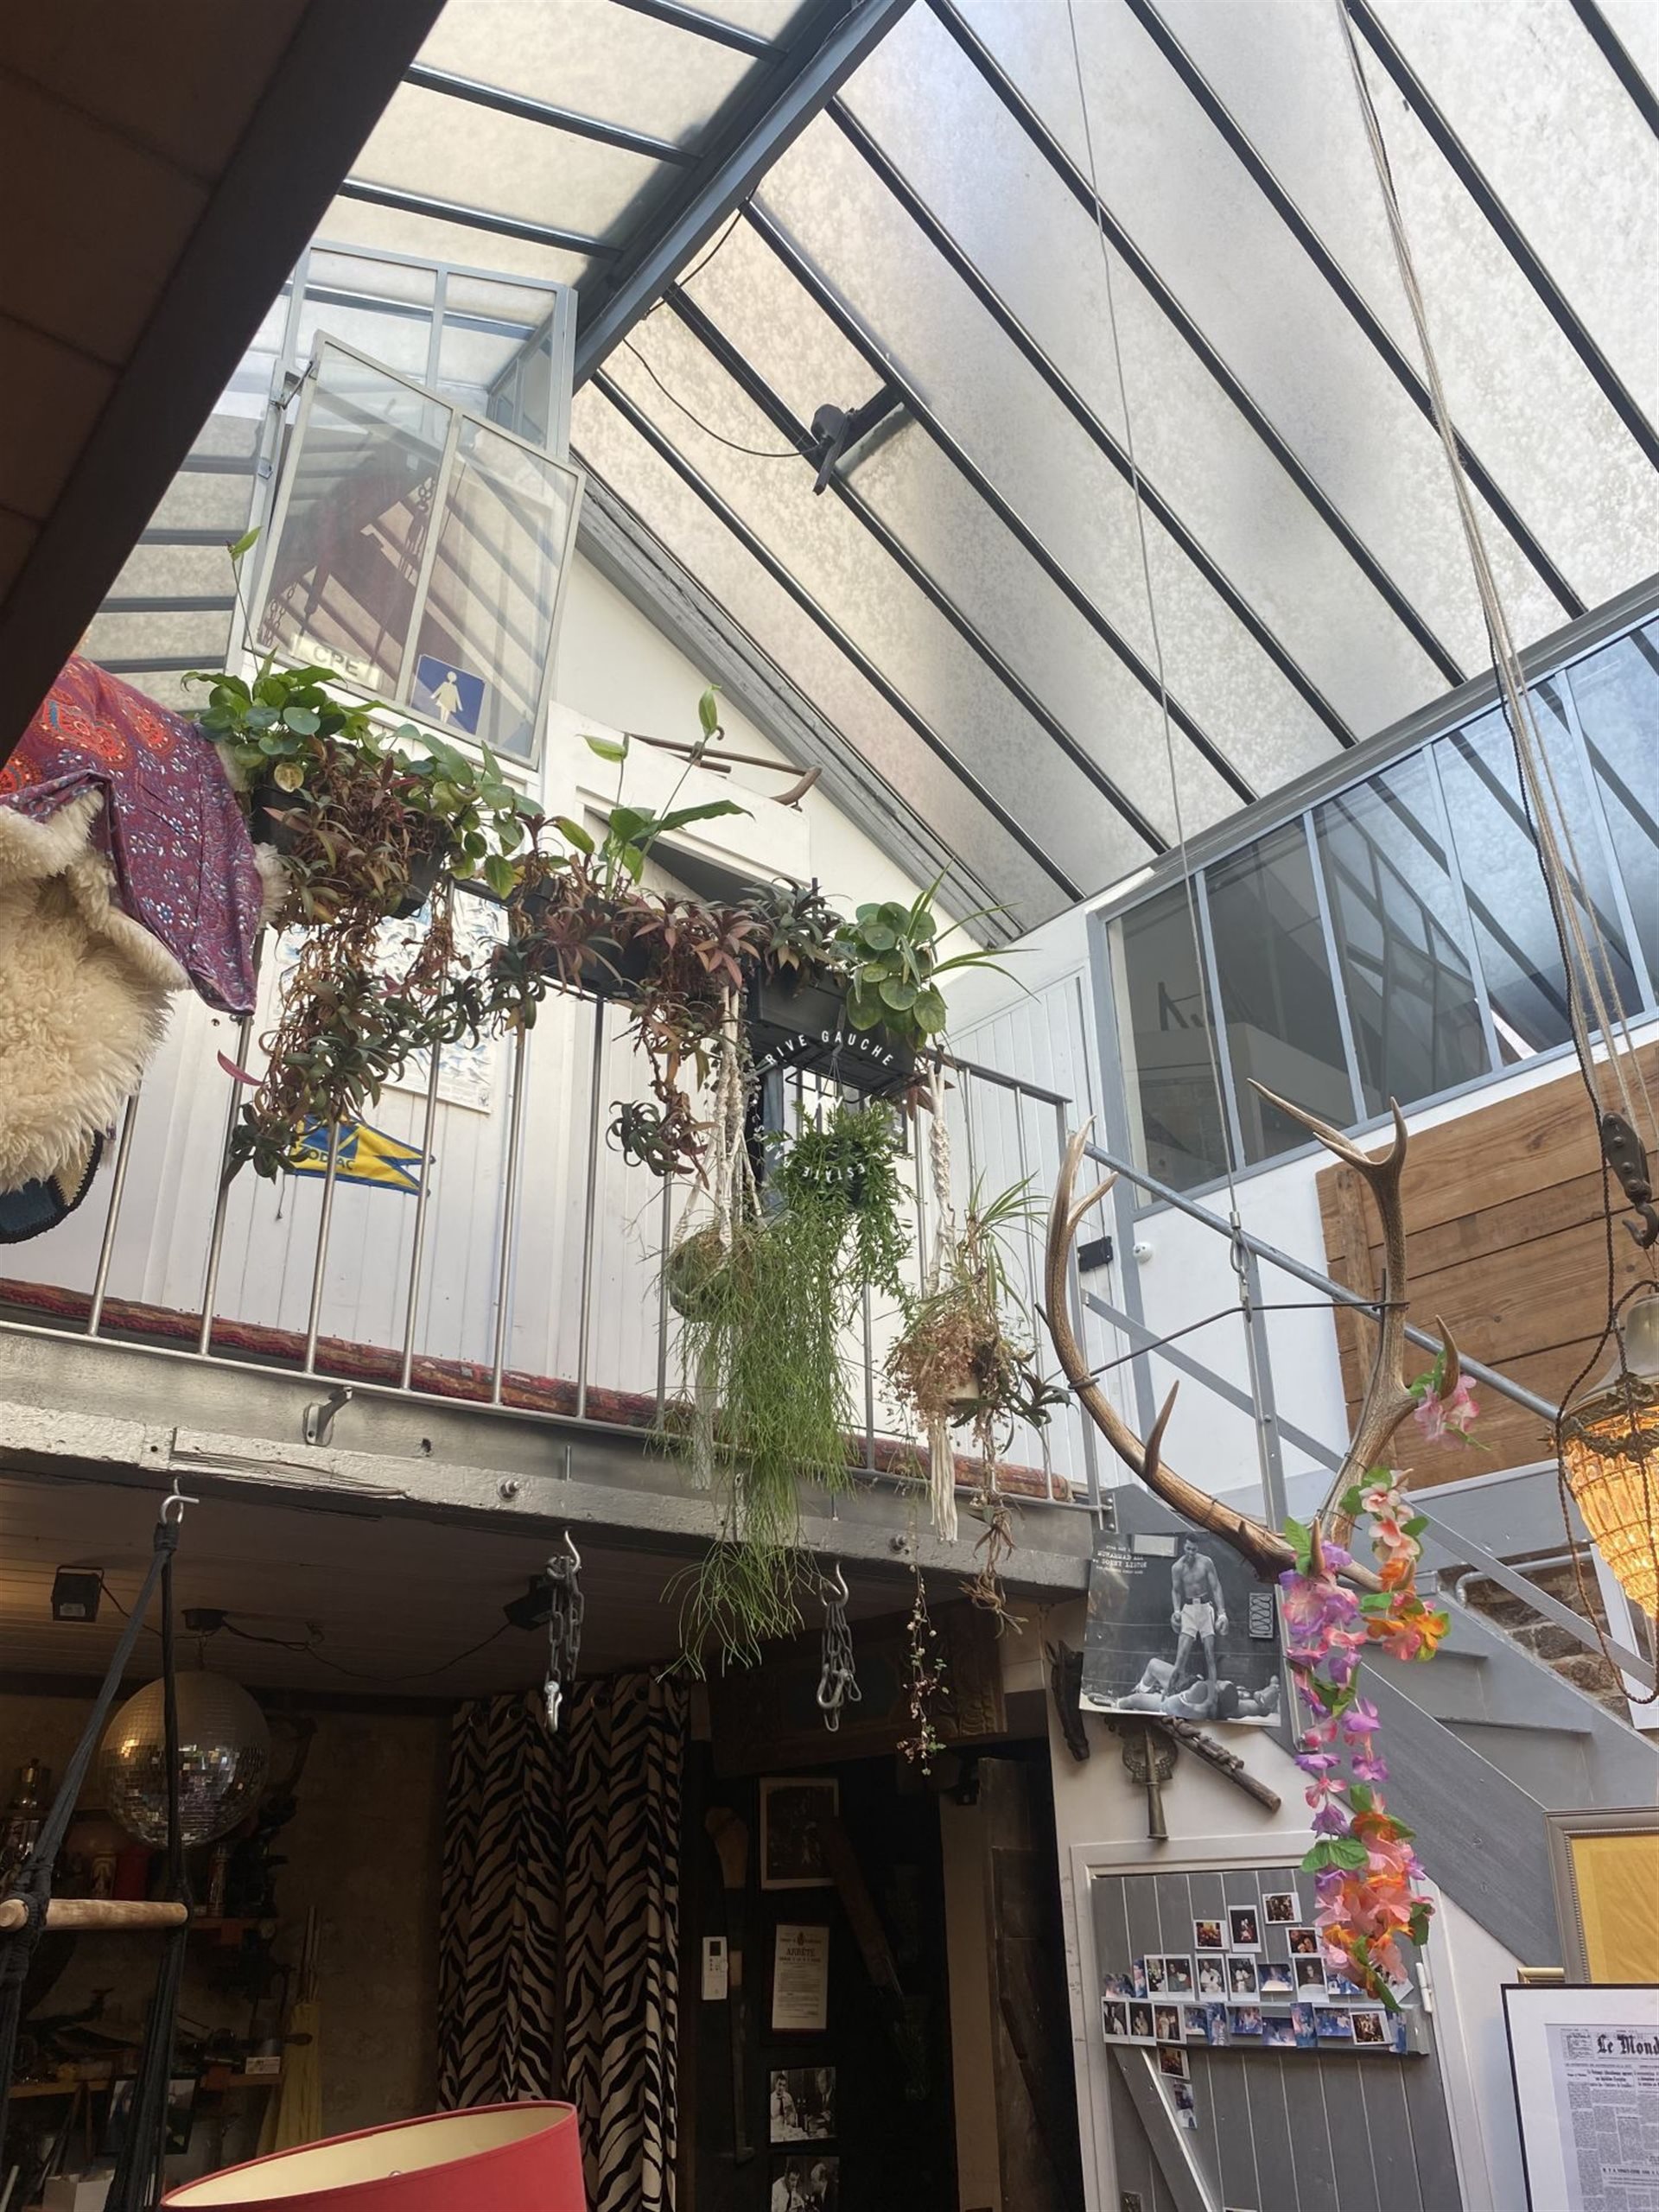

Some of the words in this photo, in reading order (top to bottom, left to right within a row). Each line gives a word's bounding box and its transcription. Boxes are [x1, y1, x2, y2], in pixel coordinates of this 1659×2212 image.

[765, 1034, 809, 1066] RIVE
[821, 1031, 893, 1067] GAUCHE
[301, 1146, 356, 1171] ODAC
[1597, 2033, 1614, 2054] Le
